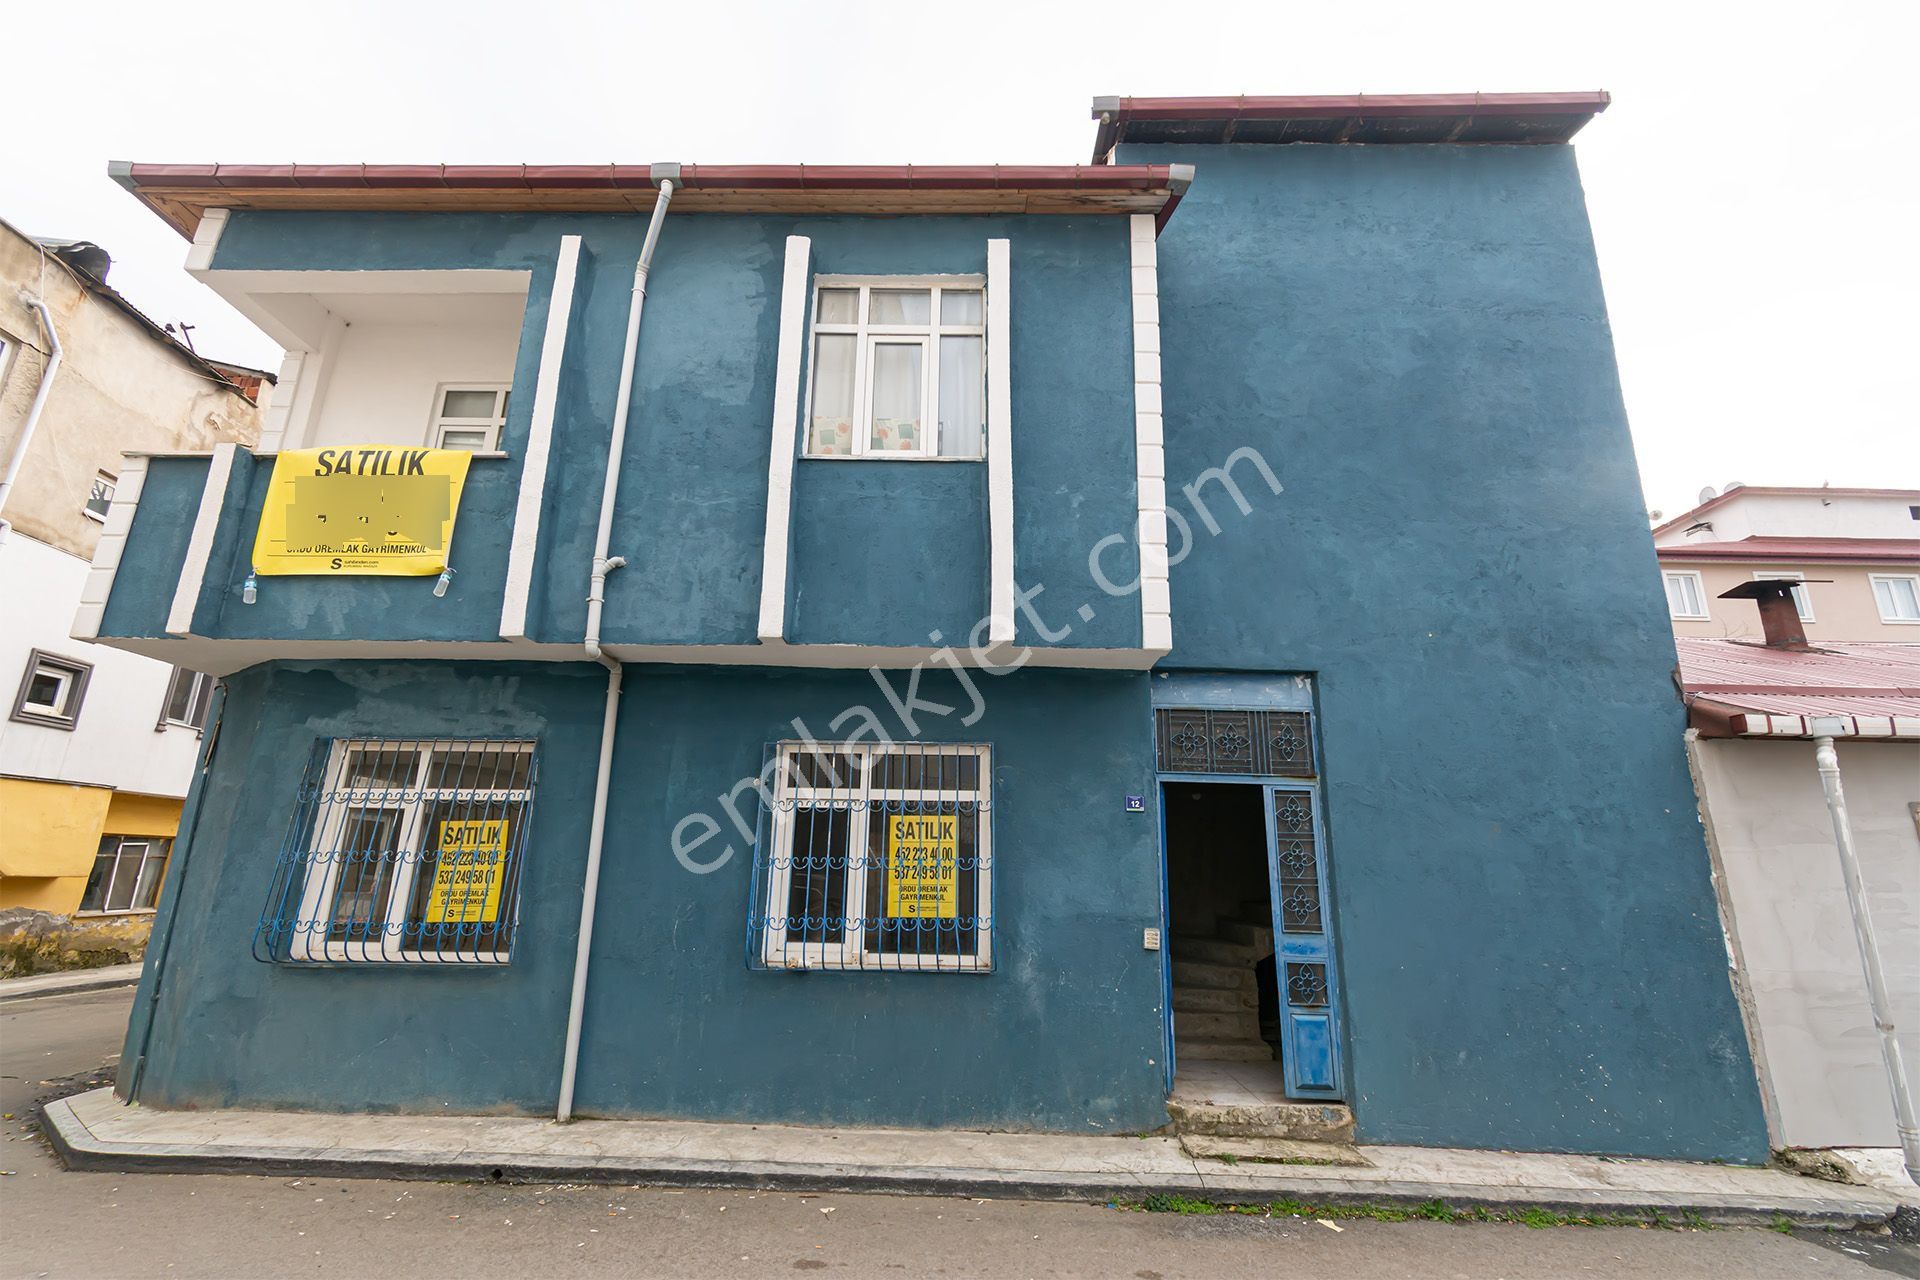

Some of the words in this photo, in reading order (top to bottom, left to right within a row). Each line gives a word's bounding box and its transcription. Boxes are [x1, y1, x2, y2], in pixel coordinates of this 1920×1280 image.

[315, 450, 430, 477] SATILIK
[1131, 800, 1140, 808] 12
[443, 826, 501, 845] SATILIK
[895, 821, 954, 840] SATILIK
[895, 846, 911, 861] 452
[942, 846, 953, 861] 00
[455, 869, 472, 885] 249
[472, 869, 484, 884] 58
[894, 865, 911, 880] 537
[942, 865, 952, 880] 01
[900, 893, 945, 901] GAYRMENKUL
